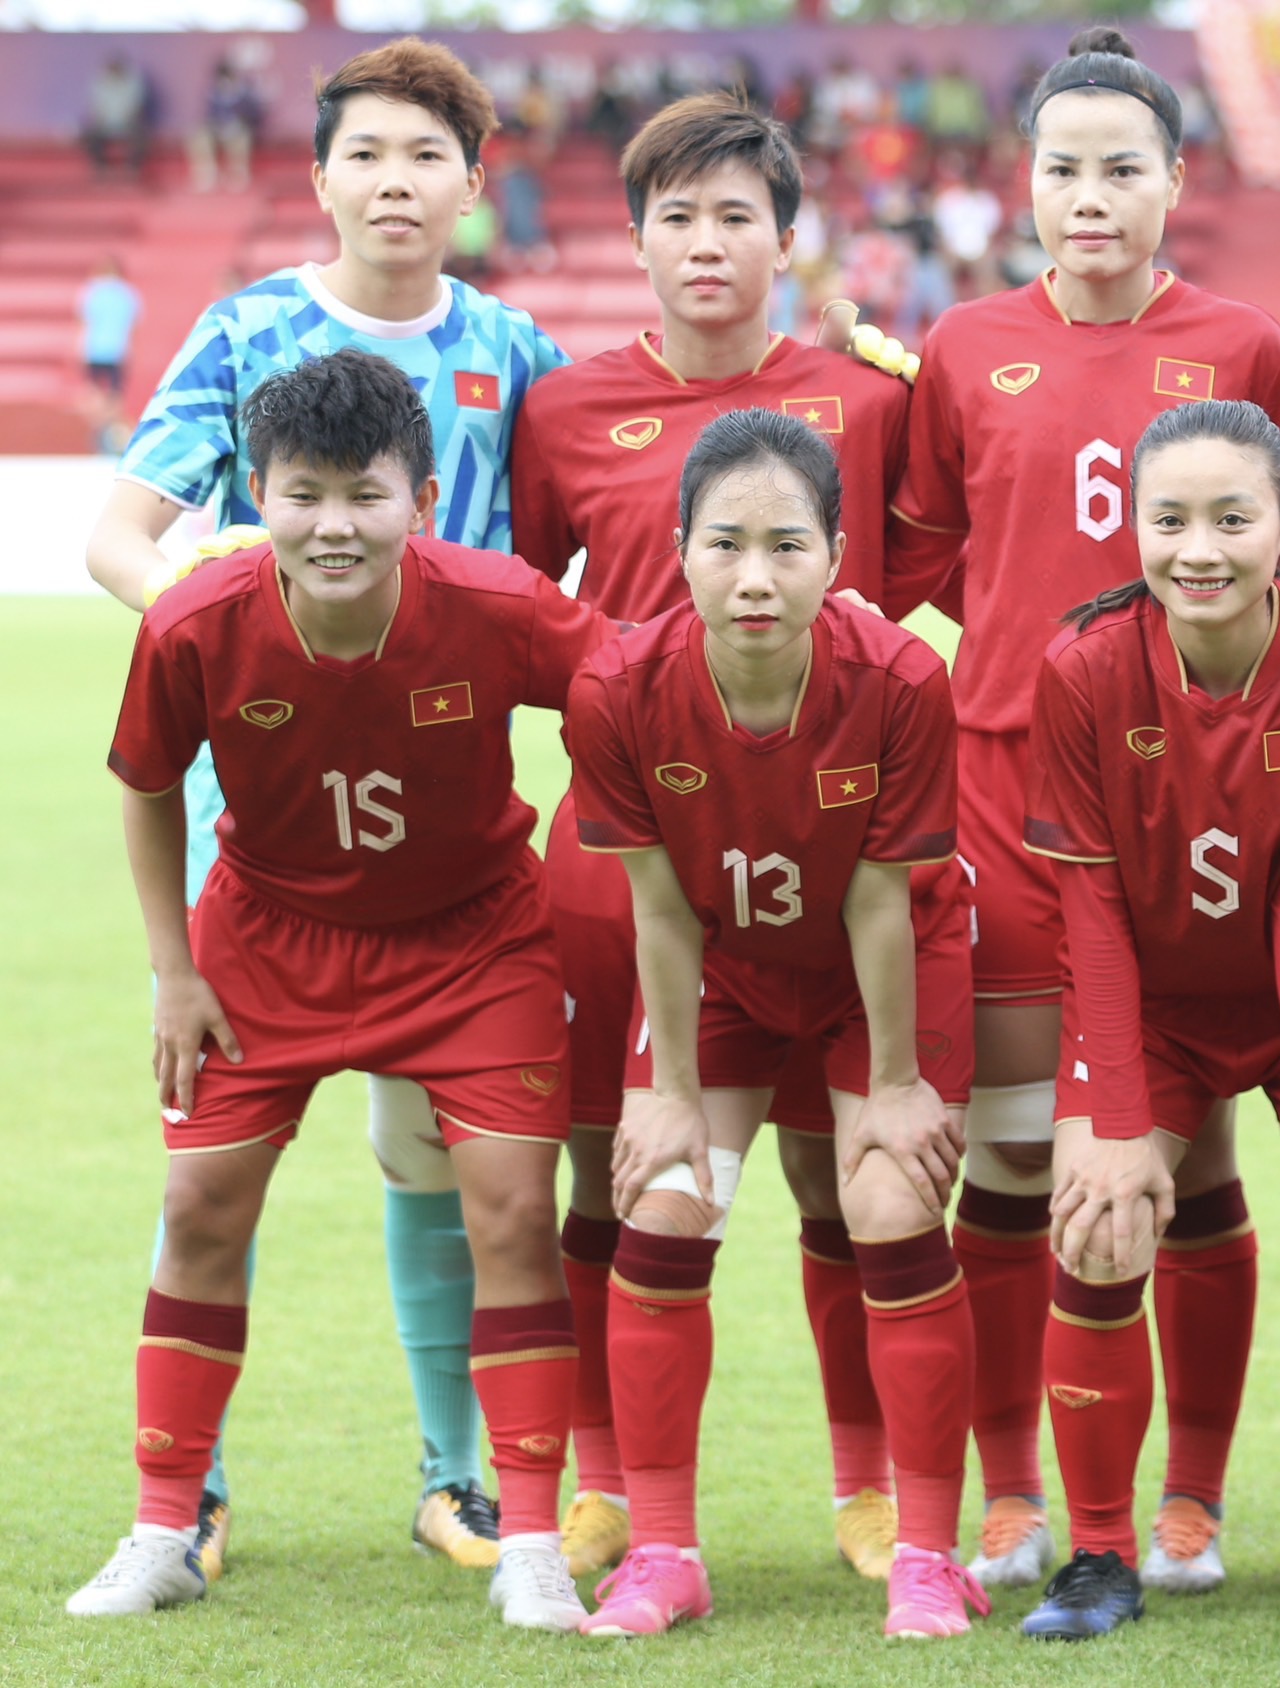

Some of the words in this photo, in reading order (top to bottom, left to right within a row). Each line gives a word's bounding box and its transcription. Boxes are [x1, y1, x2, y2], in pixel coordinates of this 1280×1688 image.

[1075, 438, 1123, 542] 6
[322, 769, 406, 852] 15
[723, 848, 803, 928] 13
